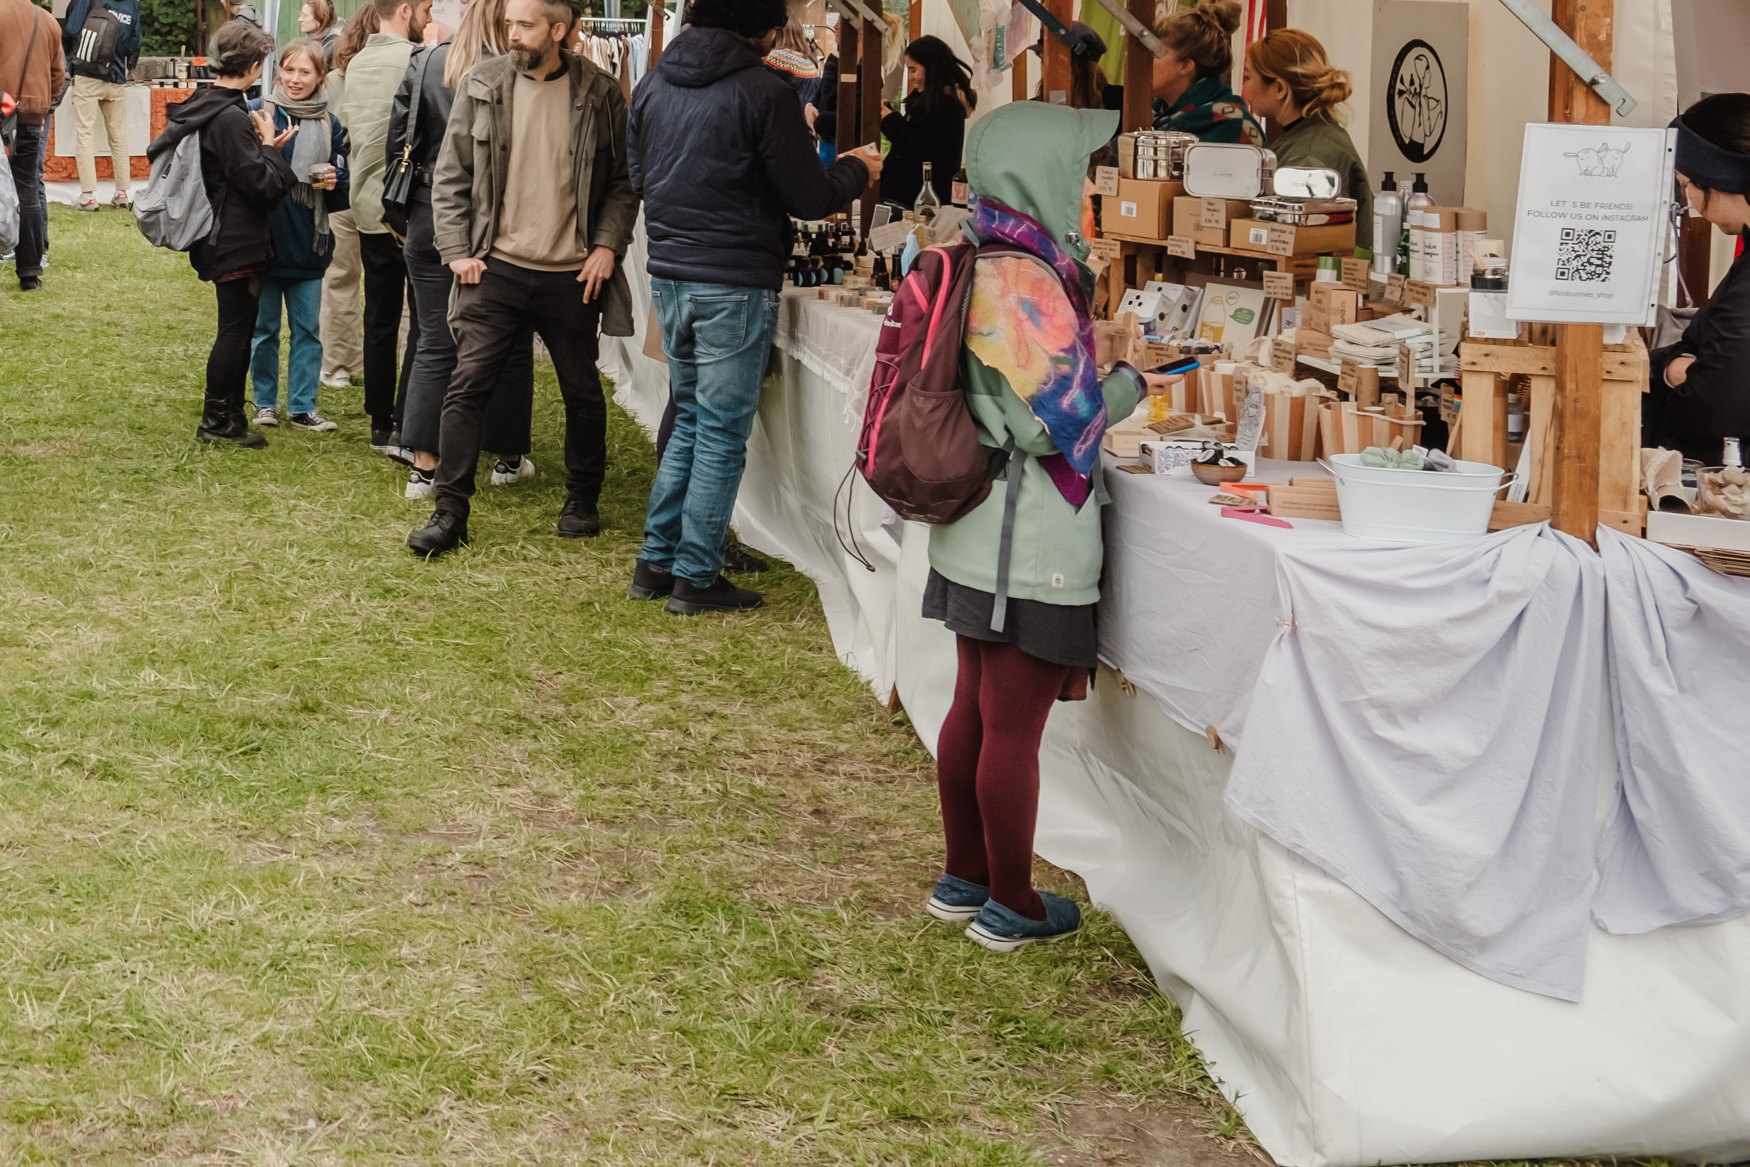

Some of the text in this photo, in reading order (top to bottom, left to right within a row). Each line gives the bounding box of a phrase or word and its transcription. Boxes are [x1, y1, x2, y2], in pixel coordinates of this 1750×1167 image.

[1580, 201, 1592, 209] BE
[1594, 202, 1634, 211] FRIENDS!
[1527, 210, 1649, 222] FOLLOW US ON INSTAGRAM
